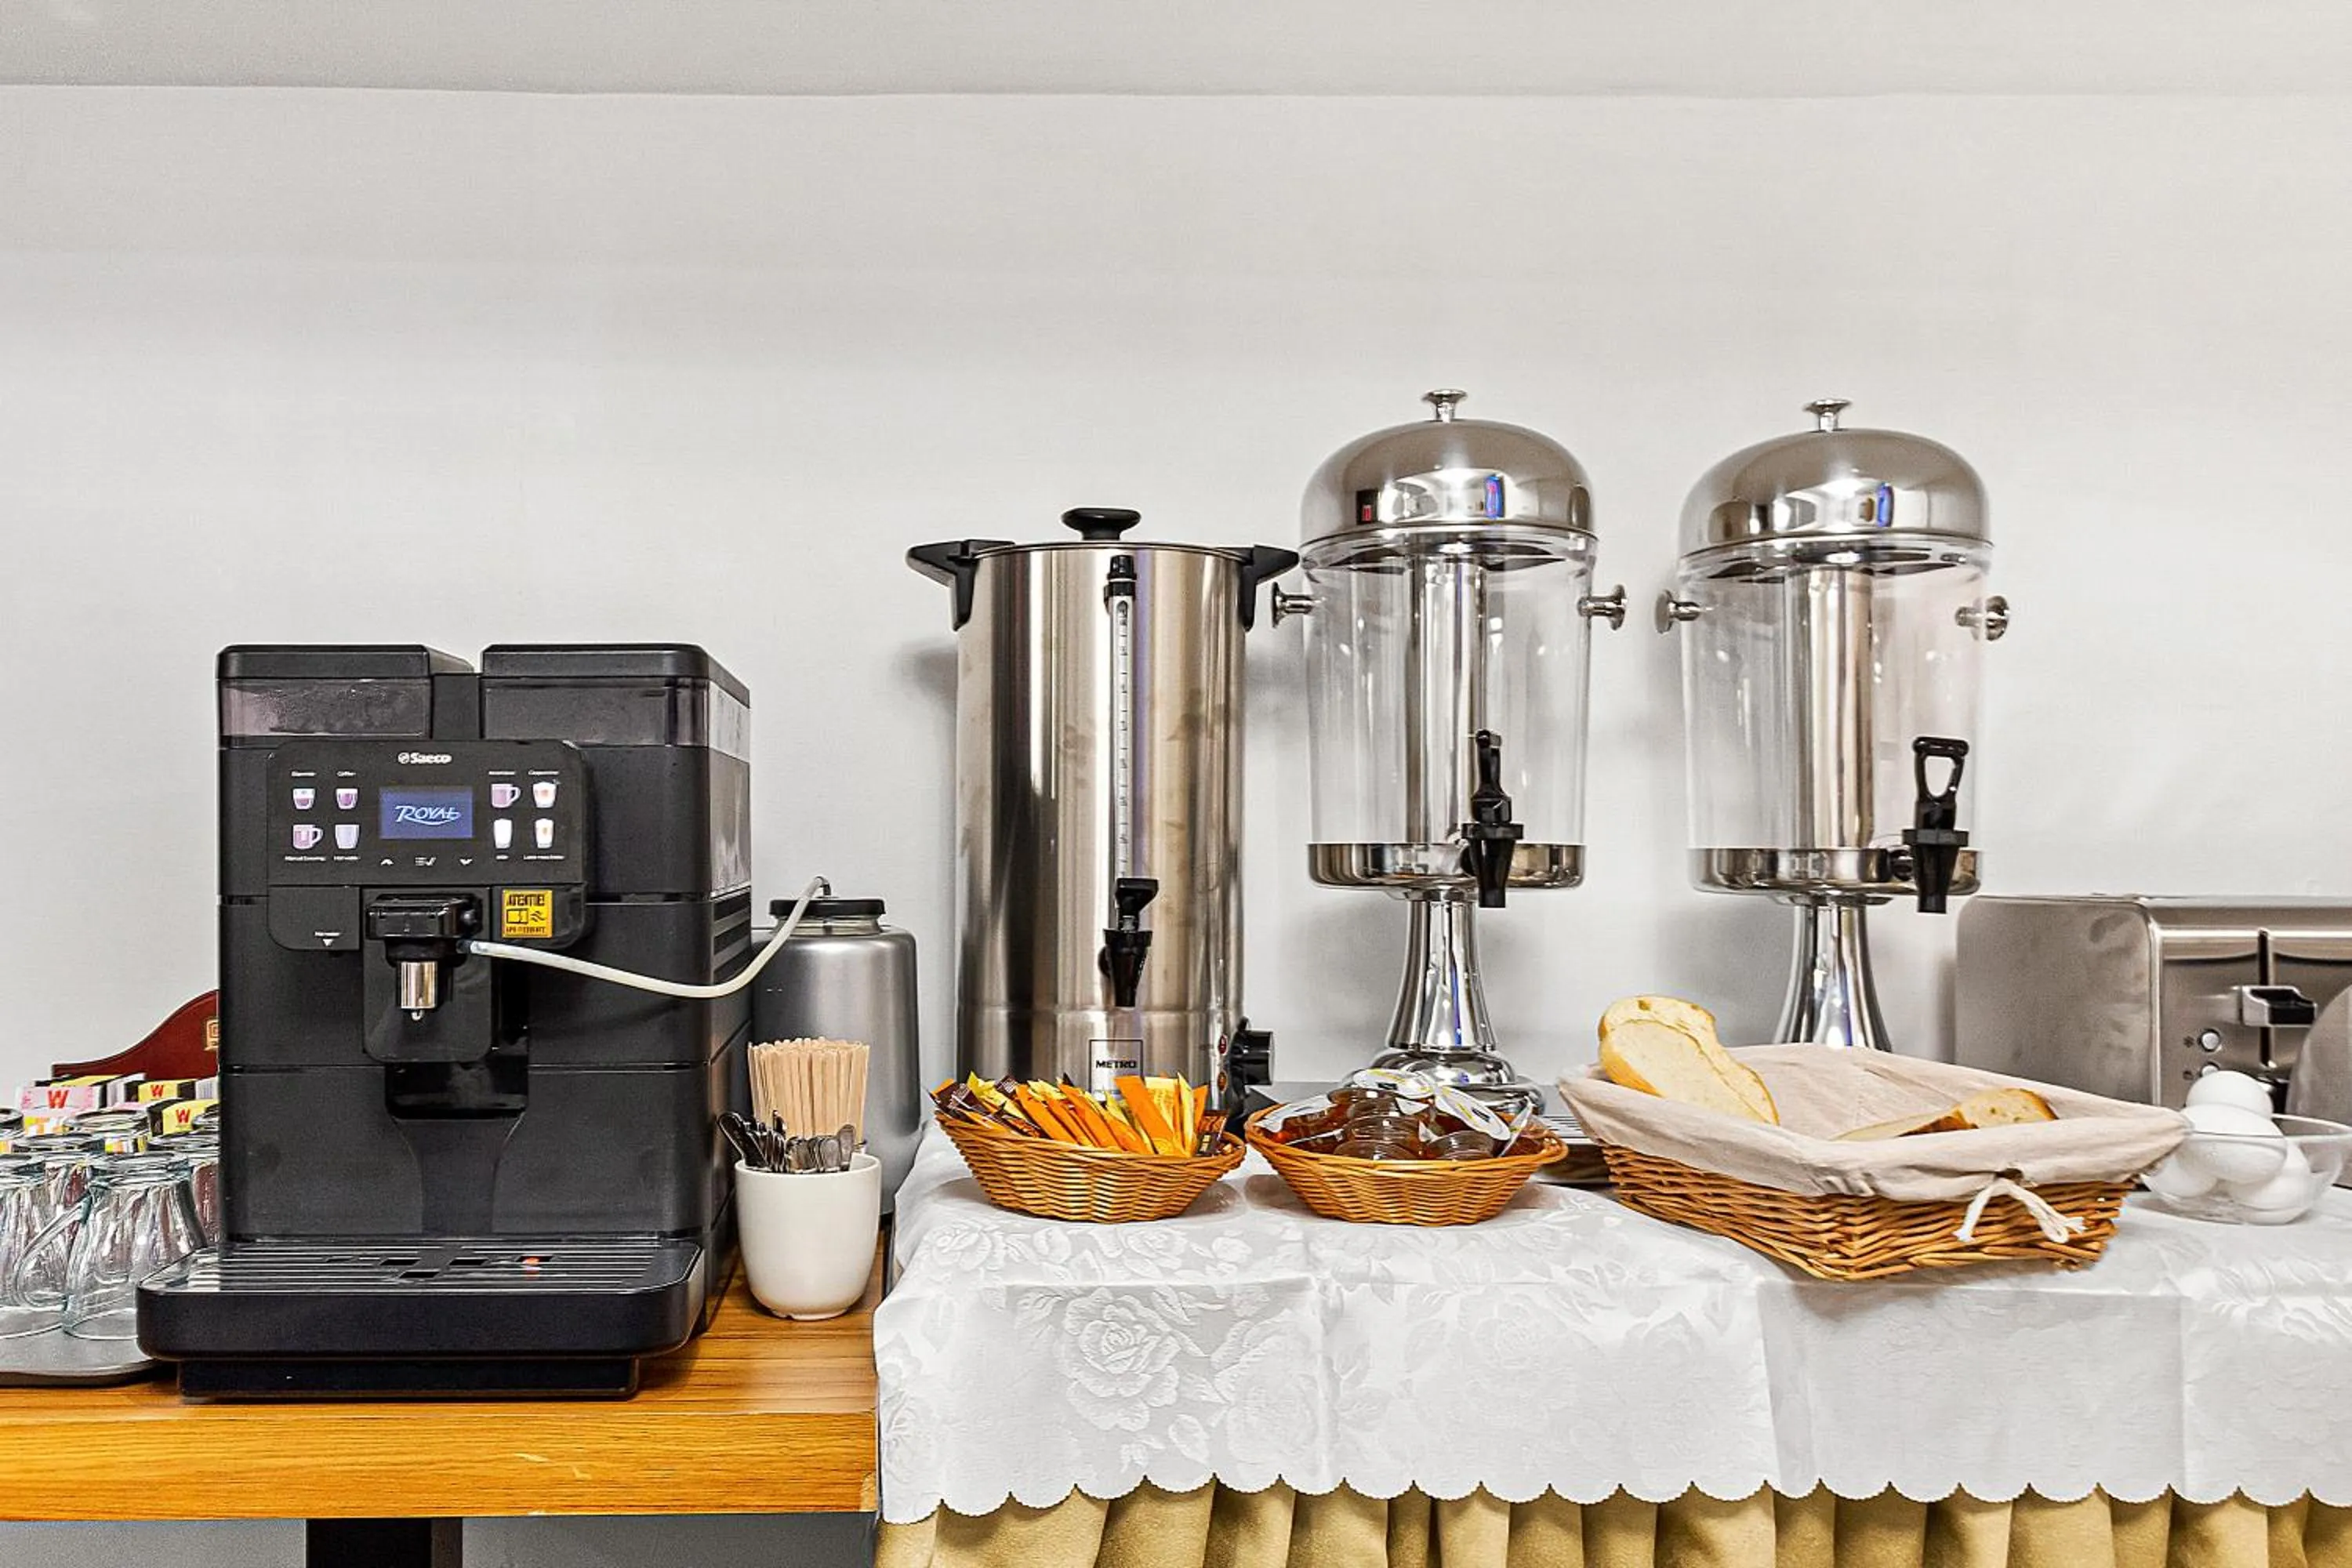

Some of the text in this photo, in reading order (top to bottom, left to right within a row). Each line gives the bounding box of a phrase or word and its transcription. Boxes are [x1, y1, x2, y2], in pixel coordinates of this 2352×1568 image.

[395, 805, 462, 826] ROYAL
[1095, 1059, 1138, 1069] METRO
[47, 1090, 69, 1109] W
[176, 1108, 191, 1123] W
